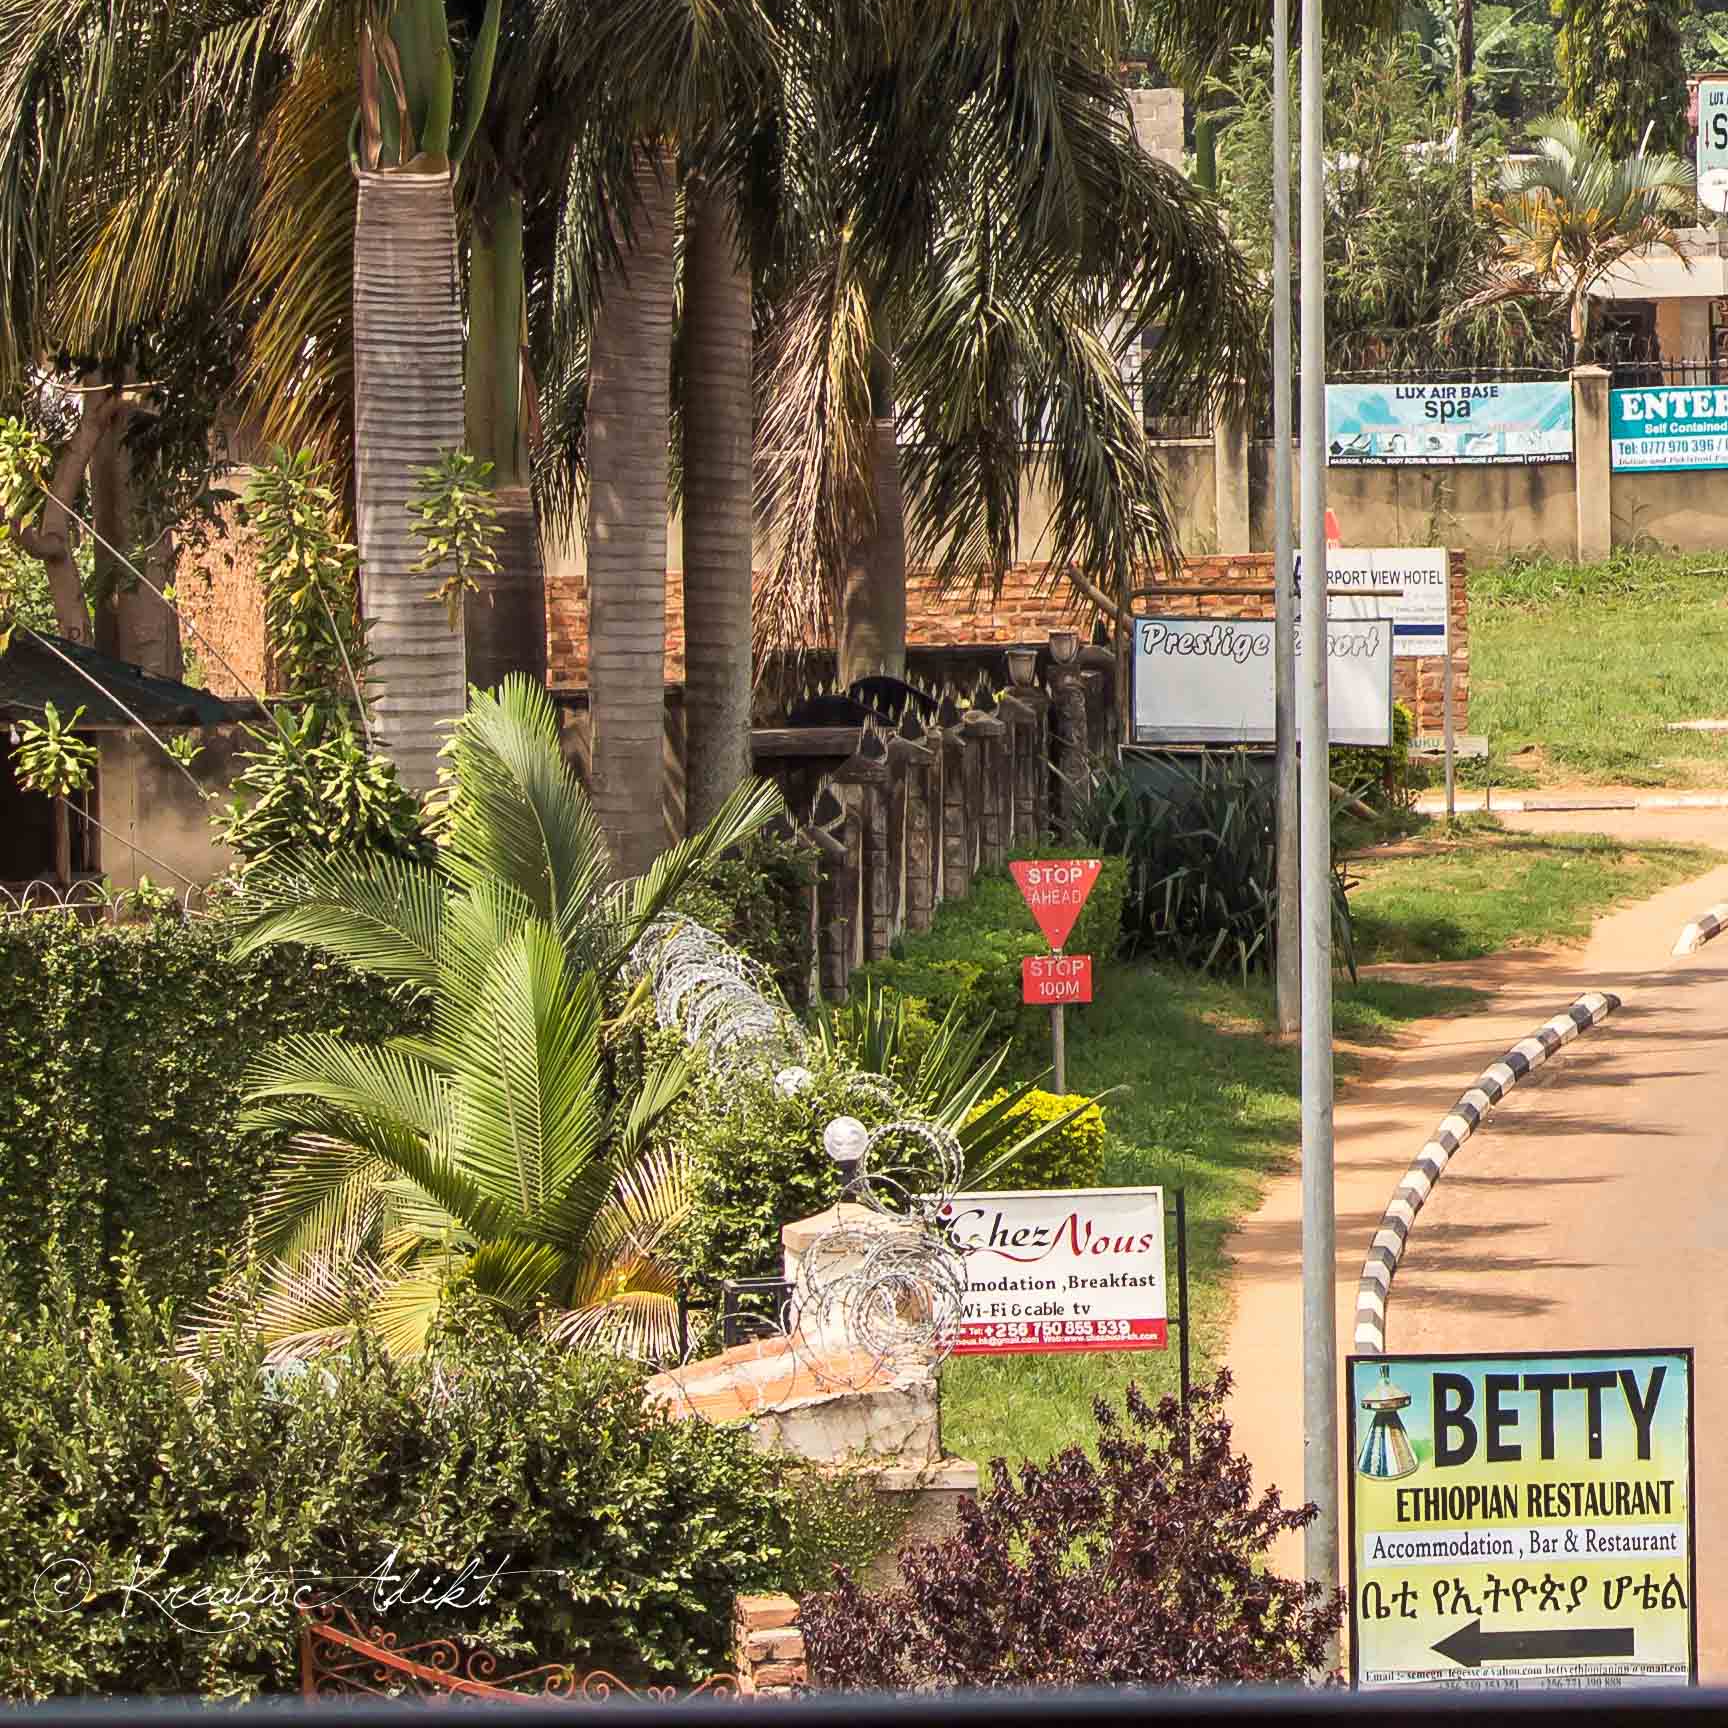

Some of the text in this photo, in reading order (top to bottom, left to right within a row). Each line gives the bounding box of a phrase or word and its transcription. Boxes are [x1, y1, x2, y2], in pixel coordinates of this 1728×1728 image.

[1709, 91, 1724, 106] LUX
[1396, 385, 1499, 400] LUX AIR BASE
[1424, 399, 1472, 424] spa
[1644, 423, 1667, 434] Self
[1669, 421, 1728, 433] Contained
[1619, 441, 1639, 455] Tel:
[1640, 440, 1665, 455] 0777
[1666, 439, 1690, 453] 970
[1691, 439, 1714, 452] 396
[1371, 570, 1400, 585] VIEW
[1404, 570, 1444, 585] HOTEL
[1142, 623, 1270, 663] Prestige
[1028, 867, 1083, 884] STOP
[1031, 889, 1081, 905] AHEAD
[1030, 960, 1084, 977] STOP
[1040, 981, 1080, 996] 100M
[944, 1208, 1154, 1257] Chez Nous
[961, 1303, 1006, 1319] Wi-Fi
[1073, 1301, 1090, 1315] tv
[984, 1323, 1028, 1337] +256
[1432, 1365, 1668, 1468] BETTY
[1396, 1480, 1674, 1522] ETHIOPIAN RESTAURANT
[1529, 1530, 1559, 1555] Bar
[1563, 1530, 1579, 1553] &
[1585, 1527, 1678, 1553] Restaurant
[1361, 1580, 1418, 1619] ቤቲ
[1602, 1573, 1687, 1611] ሆቴል
